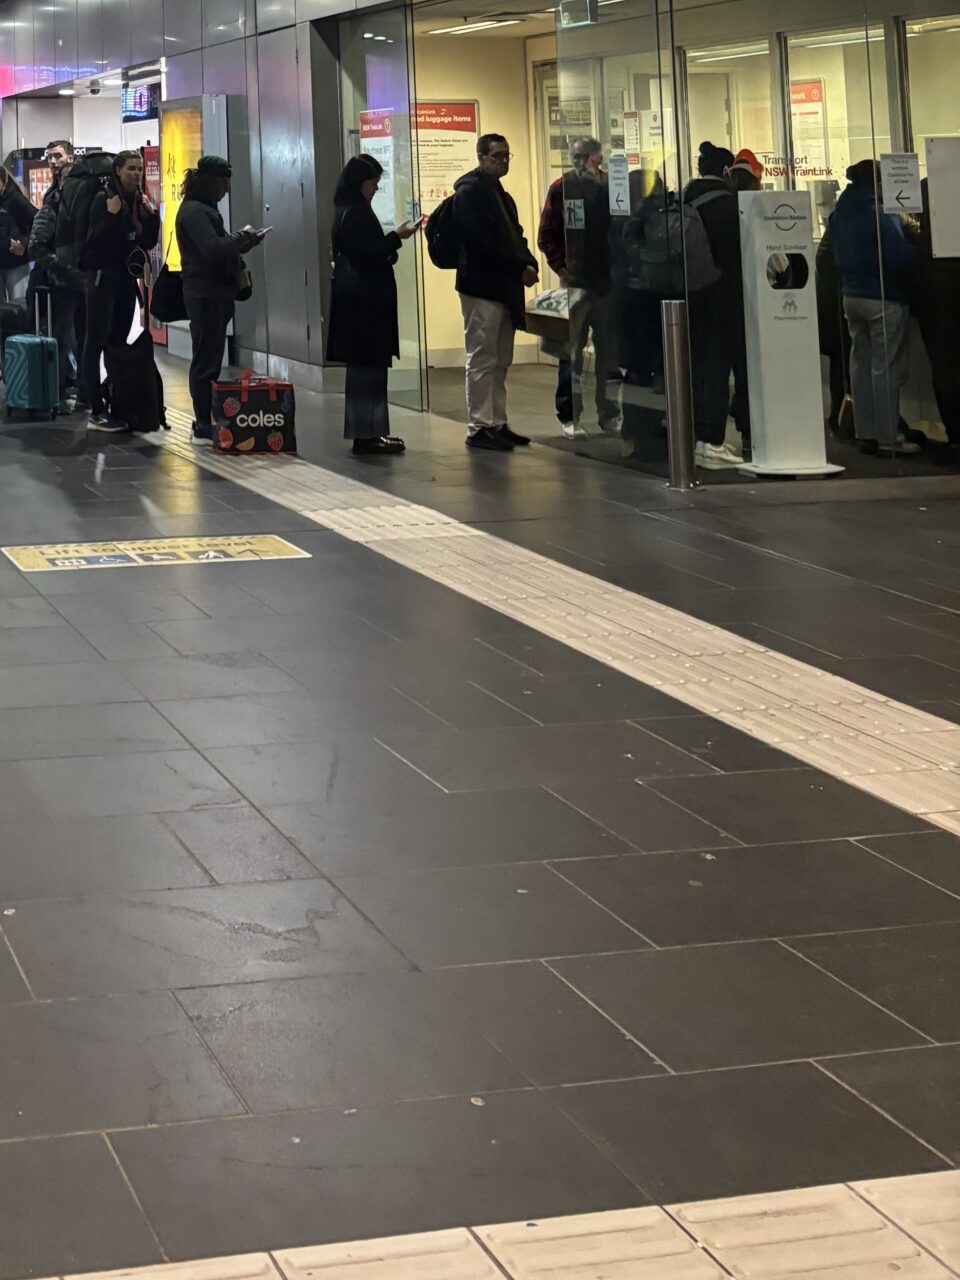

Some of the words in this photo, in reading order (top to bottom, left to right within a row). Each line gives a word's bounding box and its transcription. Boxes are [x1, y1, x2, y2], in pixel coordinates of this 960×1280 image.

[426, 115, 452, 123] luggage
[762, 155, 808, 165] Tranort
[236, 410, 285, 427] coles
[40, 548, 81, 557] Lift
[91, 547, 117, 555] to
[124, 543, 191, 554] upper
[198, 540, 254, 549] level
